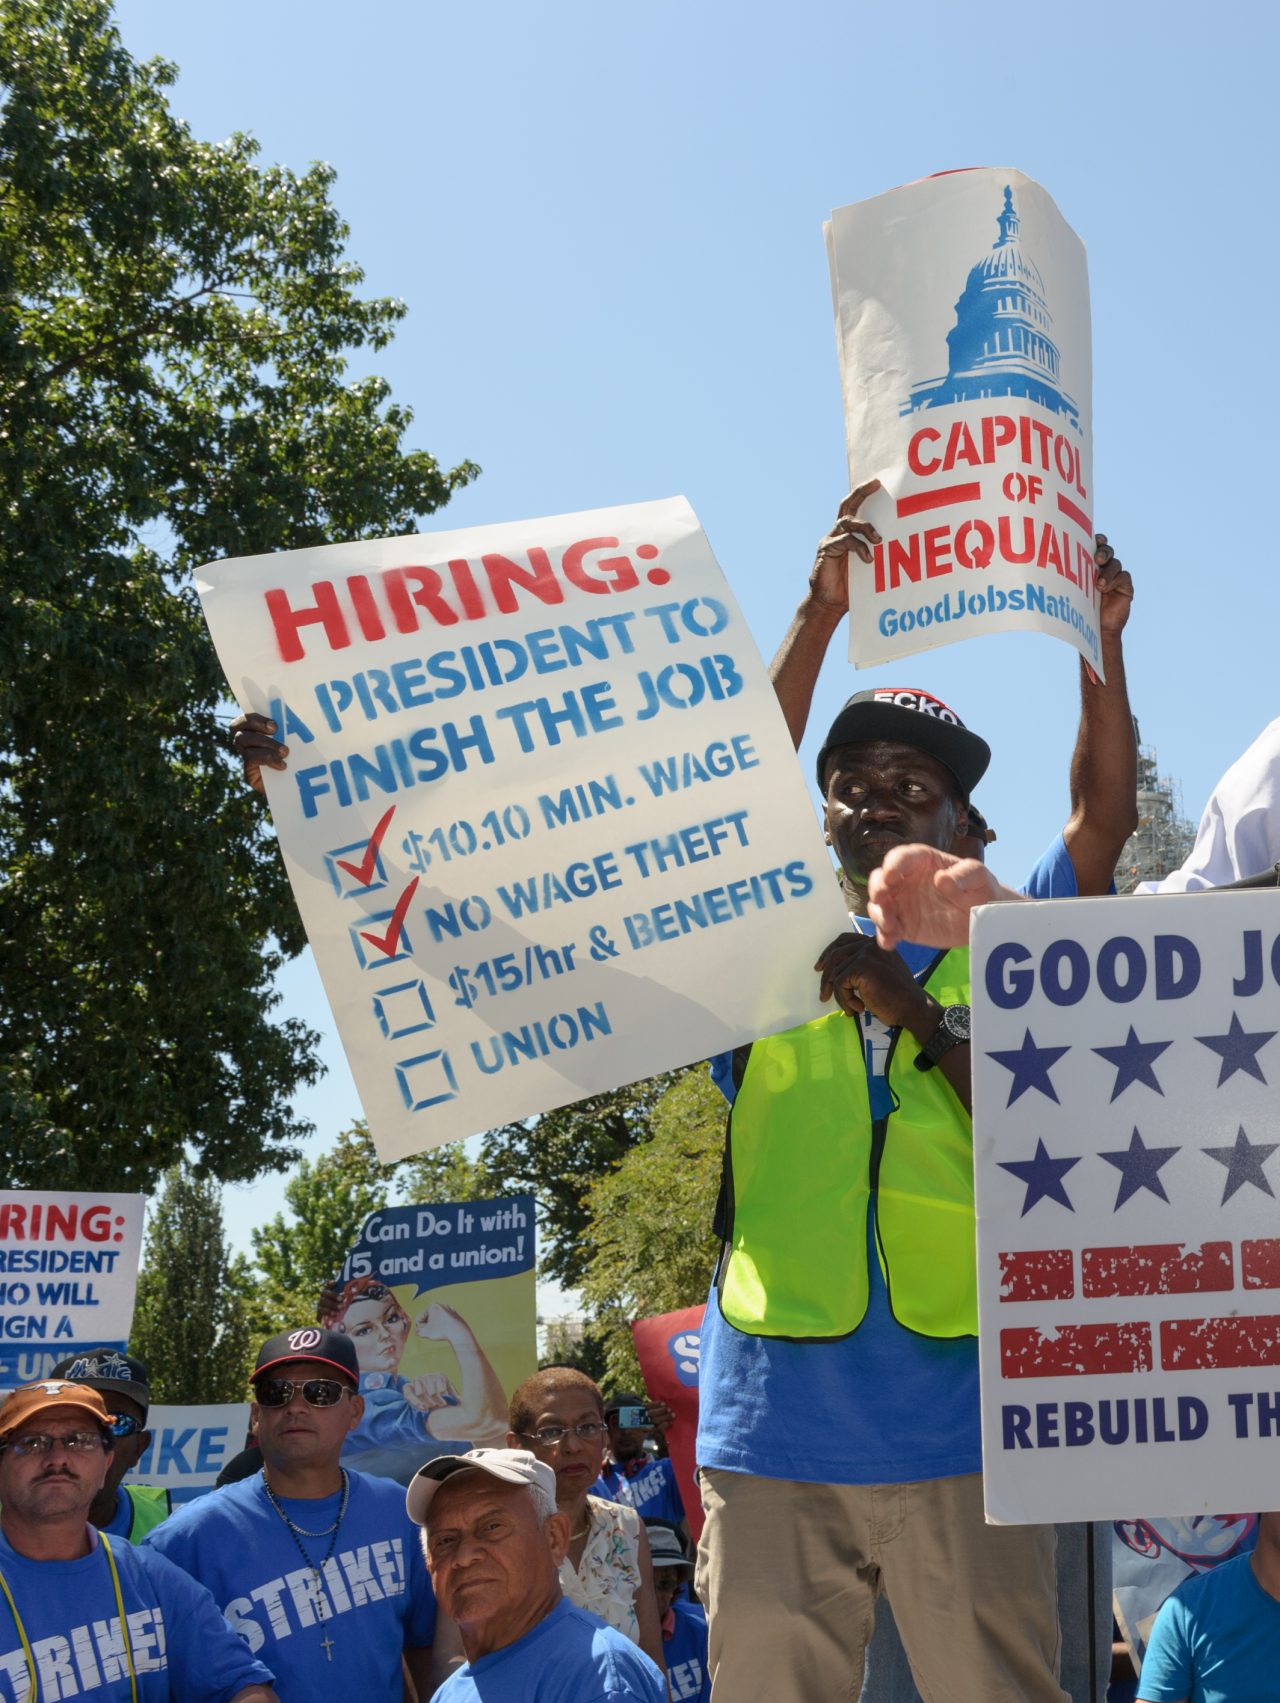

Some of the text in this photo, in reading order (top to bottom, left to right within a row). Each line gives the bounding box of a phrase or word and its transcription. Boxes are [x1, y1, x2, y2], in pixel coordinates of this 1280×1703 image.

[907, 415, 1087, 499] CAPITOL
[1002, 471, 1044, 504] OF
[264, 535, 672, 663] HIRING:
[873, 515, 1098, 609] INEQUALITY
[878, 583, 1098, 662] GoodJobsNation.org
[268, 596, 729, 745] A PRESIDENT TO
[294, 653, 745, 819] FINISH THE JOB
[401, 733, 761, 875] $10.10 MIN. WAGE
[424, 810, 751, 944] NO WAGE THEFT
[448, 860, 815, 1010] $15/hr & BENEFITS
[985, 934, 1202, 1010] GOOD
[469, 1001, 614, 1076] UNION
[336, 1235, 525, 1282] 15 and a union!
[365, 1216, 410, 1244] Can
[416, 1211, 451, 1238] Do
[457, 1208, 475, 1235] It
[480, 1203, 527, 1232] with
[37, 1282, 100, 1306] WILL
[53, 1315, 74, 1338] A
[129, 1427, 229, 1475] IKE
[1001, 1395, 1209, 1450] REBUILD
[223, 1538, 406, 1654] STRIKE!
[0, 1608, 168, 1703] TRIKE!
